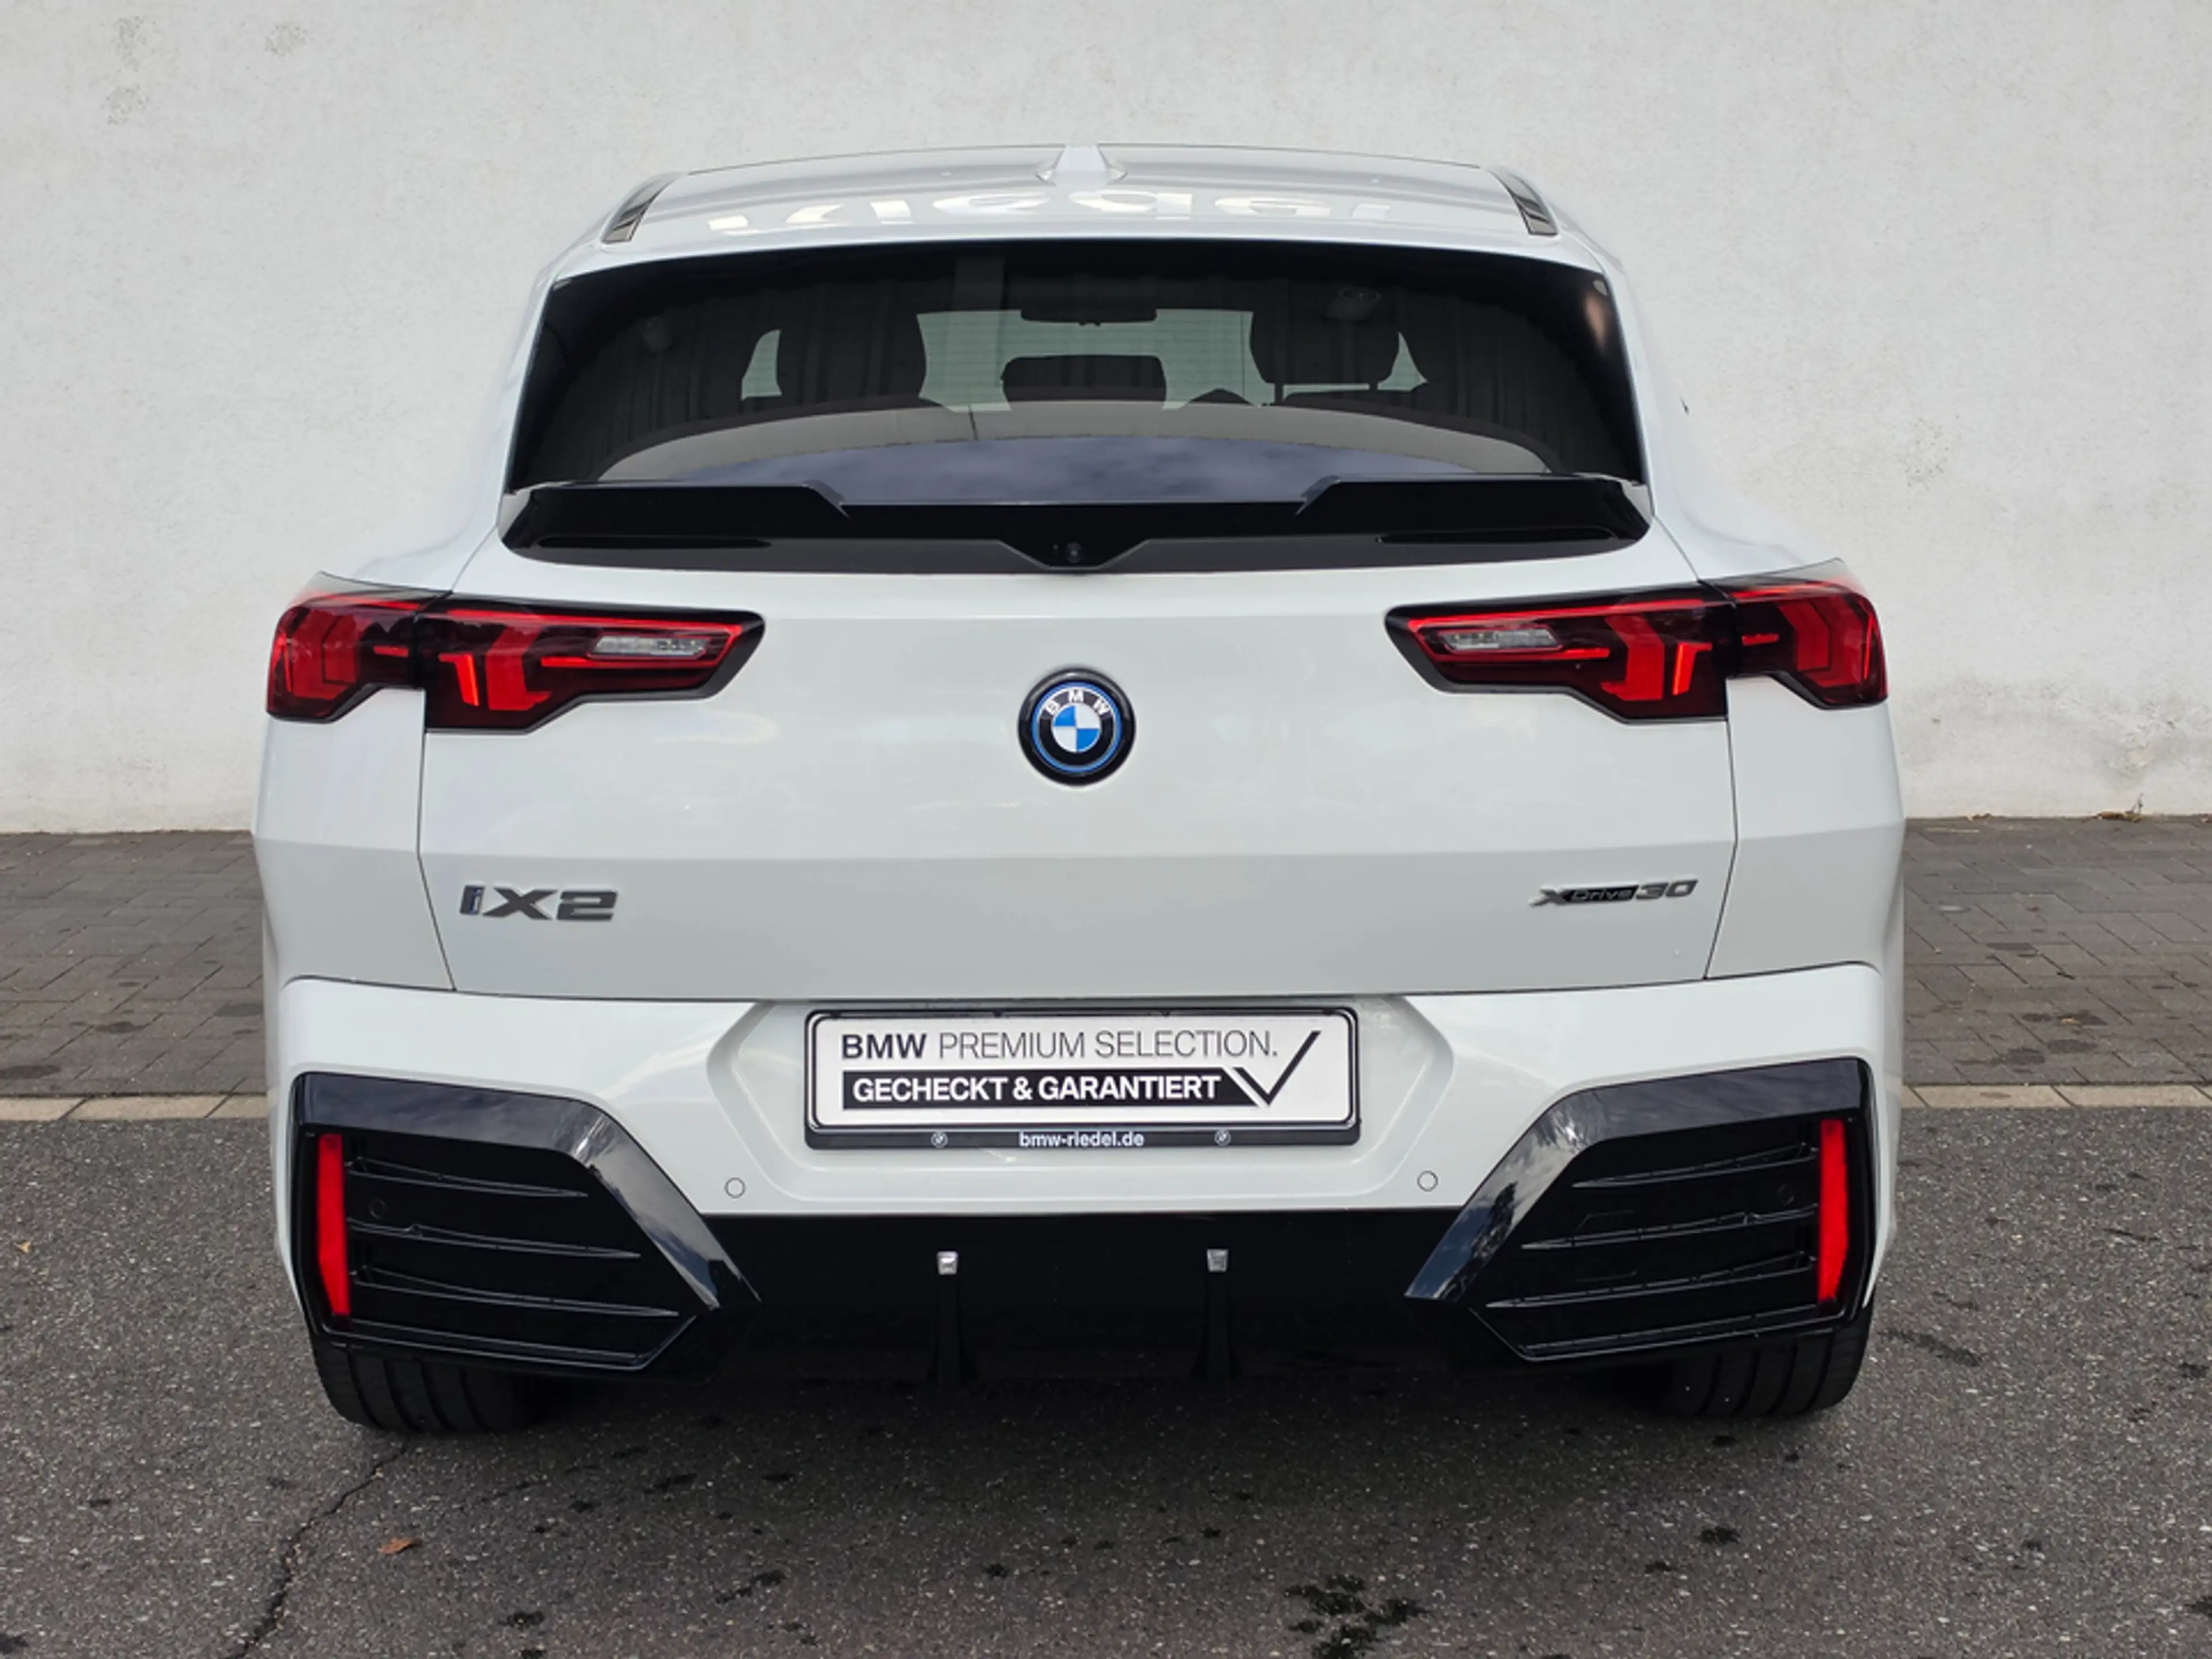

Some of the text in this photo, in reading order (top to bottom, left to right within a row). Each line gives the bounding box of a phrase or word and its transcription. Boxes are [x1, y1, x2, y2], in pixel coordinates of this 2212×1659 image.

[1045, 688, 1111, 715] BMW
[842, 1030, 1277, 1060] BMW PREMIUM SELECTION.
[853, 1075, 1221, 1102] GECHECKT & GARANTIERT
[1019, 1131, 1144, 1148] bmw-riedel.de
